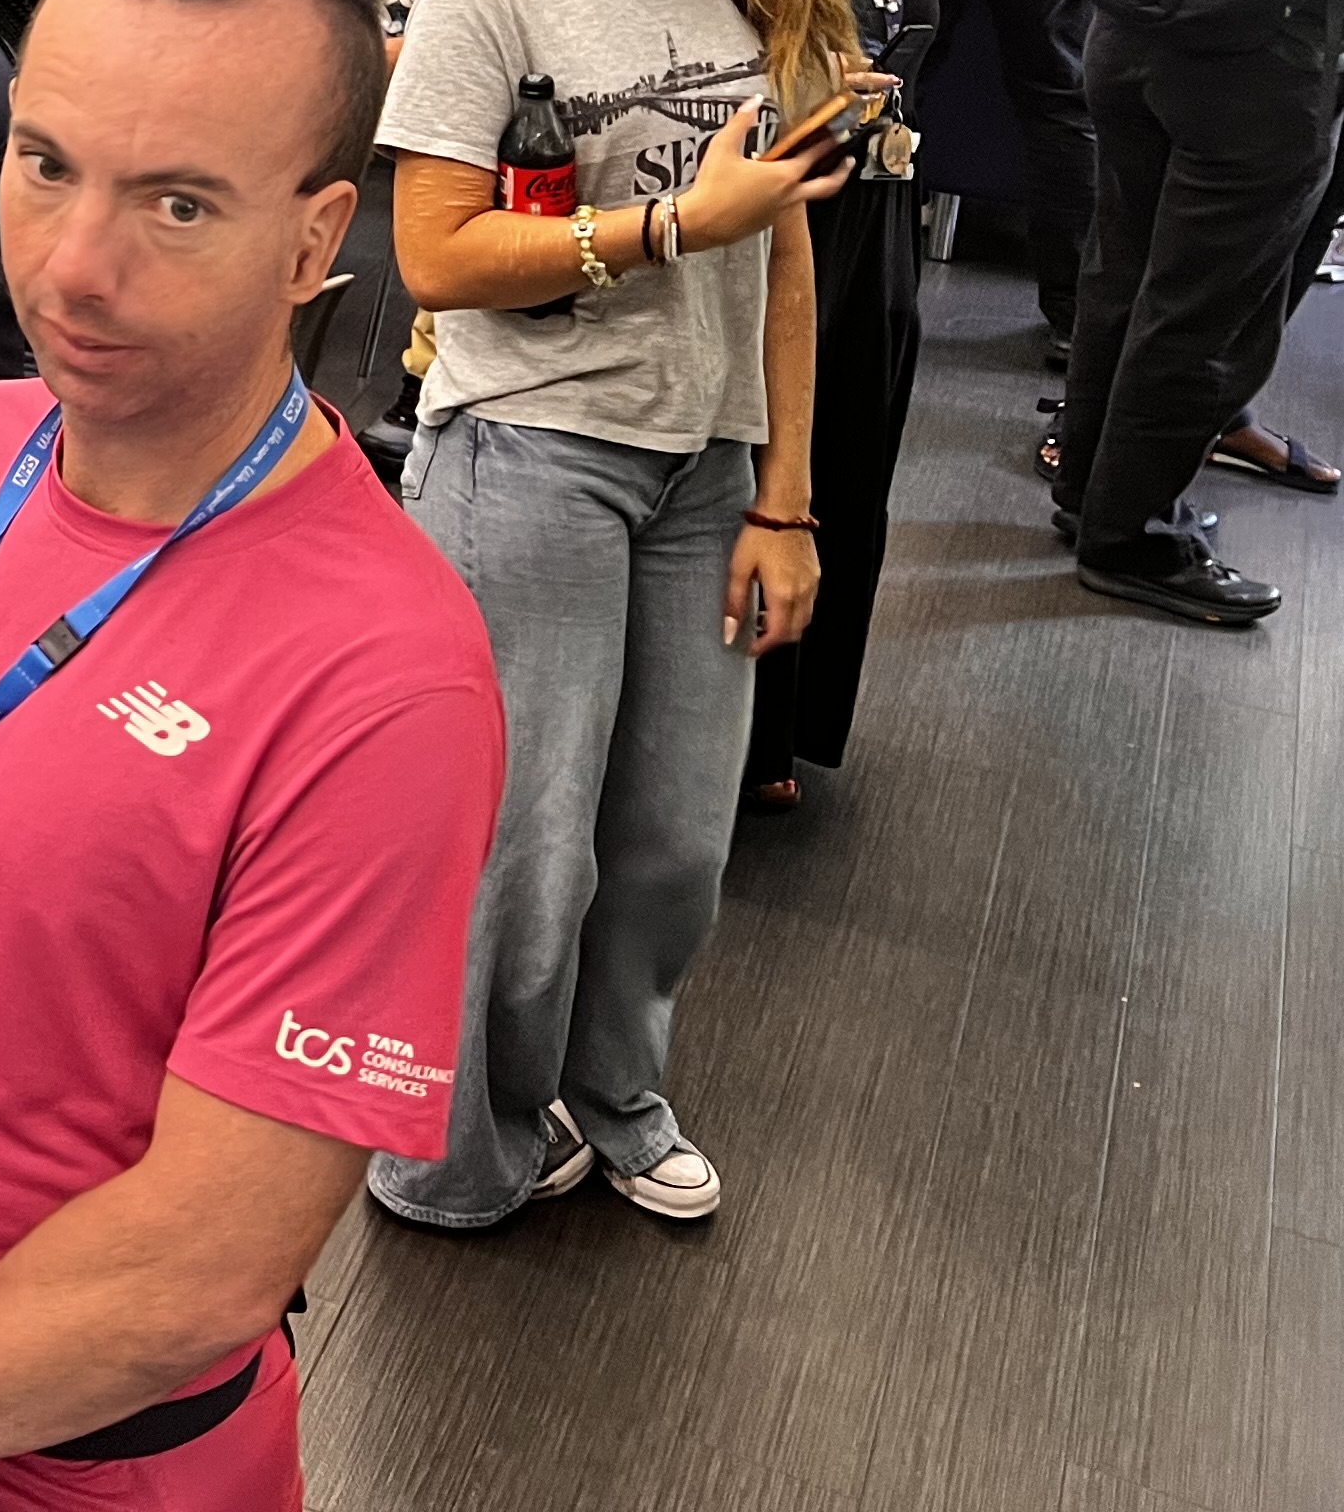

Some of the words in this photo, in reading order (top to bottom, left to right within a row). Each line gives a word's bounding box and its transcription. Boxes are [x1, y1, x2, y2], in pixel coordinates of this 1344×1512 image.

[14, 455, 38, 486] NHS
[275, 1009, 356, 1075] tcs
[367, 1033, 415, 1058] TATA
[357, 1068, 428, 1097] SERVICES
